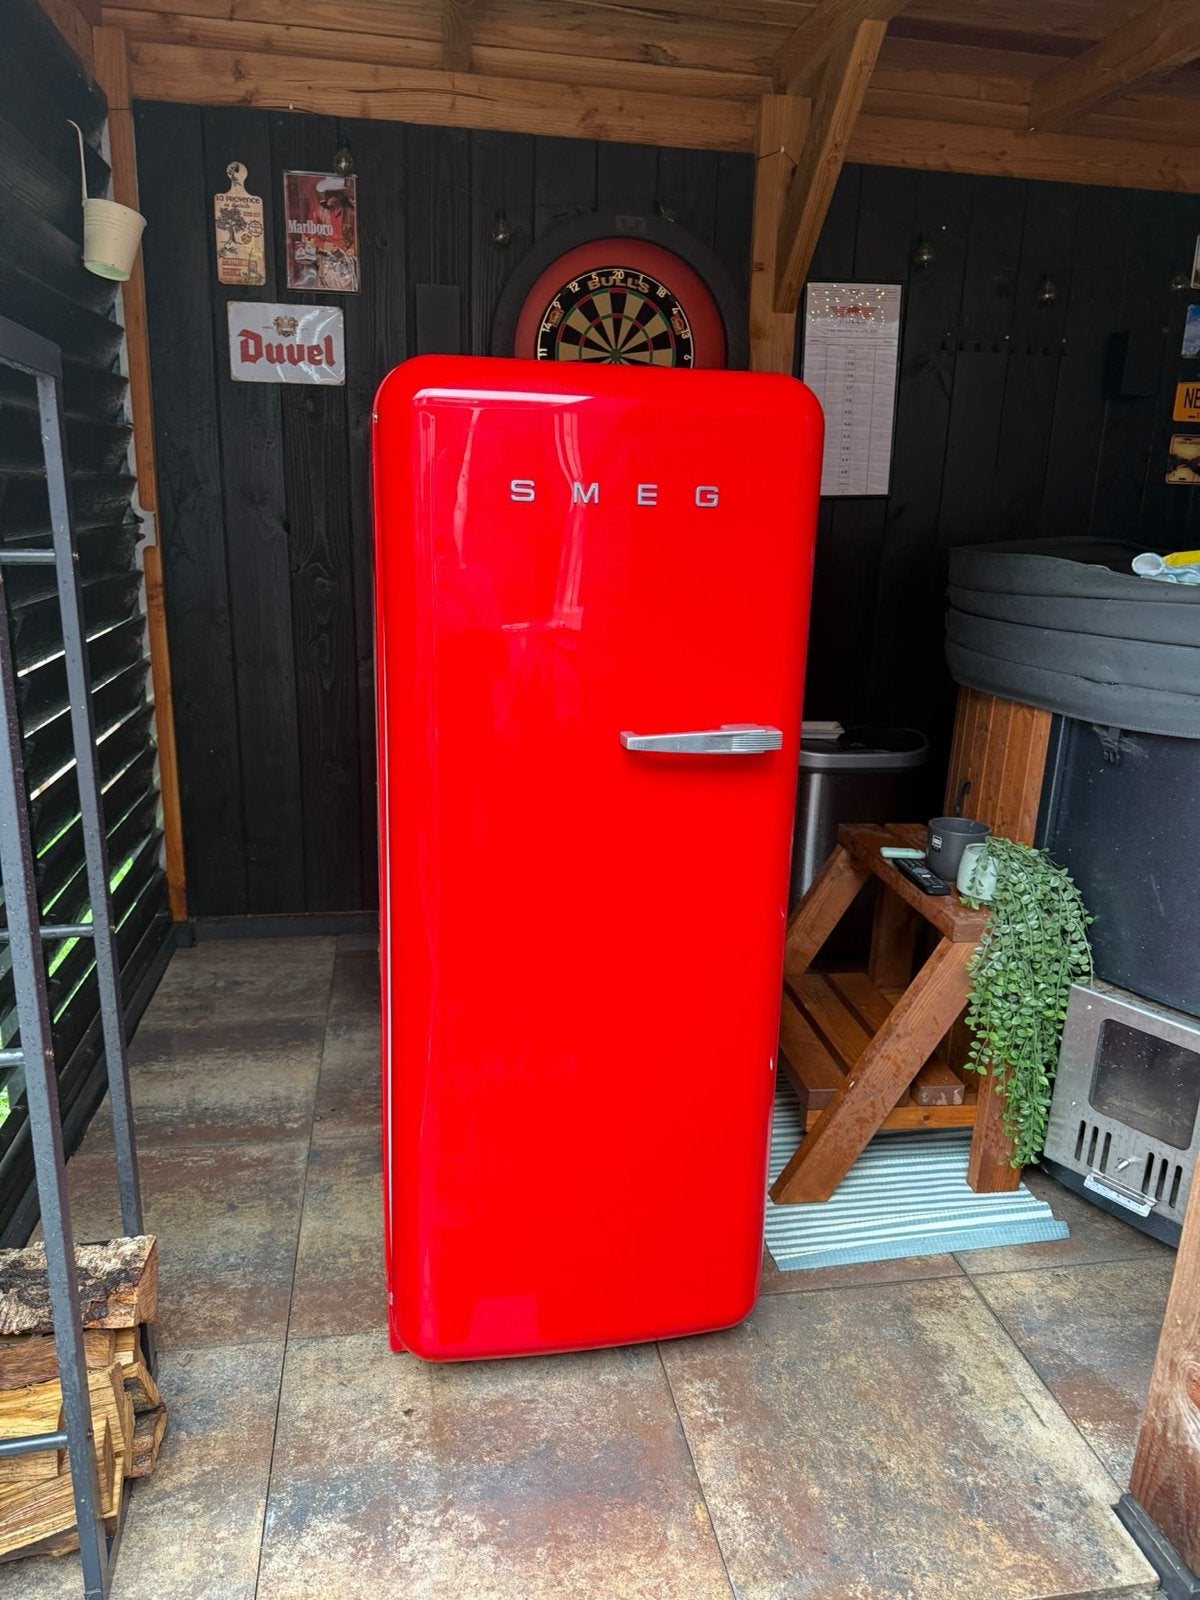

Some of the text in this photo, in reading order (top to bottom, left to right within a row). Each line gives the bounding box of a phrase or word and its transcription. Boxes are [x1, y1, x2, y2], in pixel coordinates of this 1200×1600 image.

[288, 219, 333, 235] Marlboro
[591, 273, 599, 282] 5
[612, 270, 624, 280] 20
[568, 282, 581, 294] 12
[656, 286, 666, 298] 18
[542, 322, 552, 333] 14
[681, 329, 691, 340] 13
[237, 328, 336, 367] Duvel
[511, 479, 719, 507] SMEG
